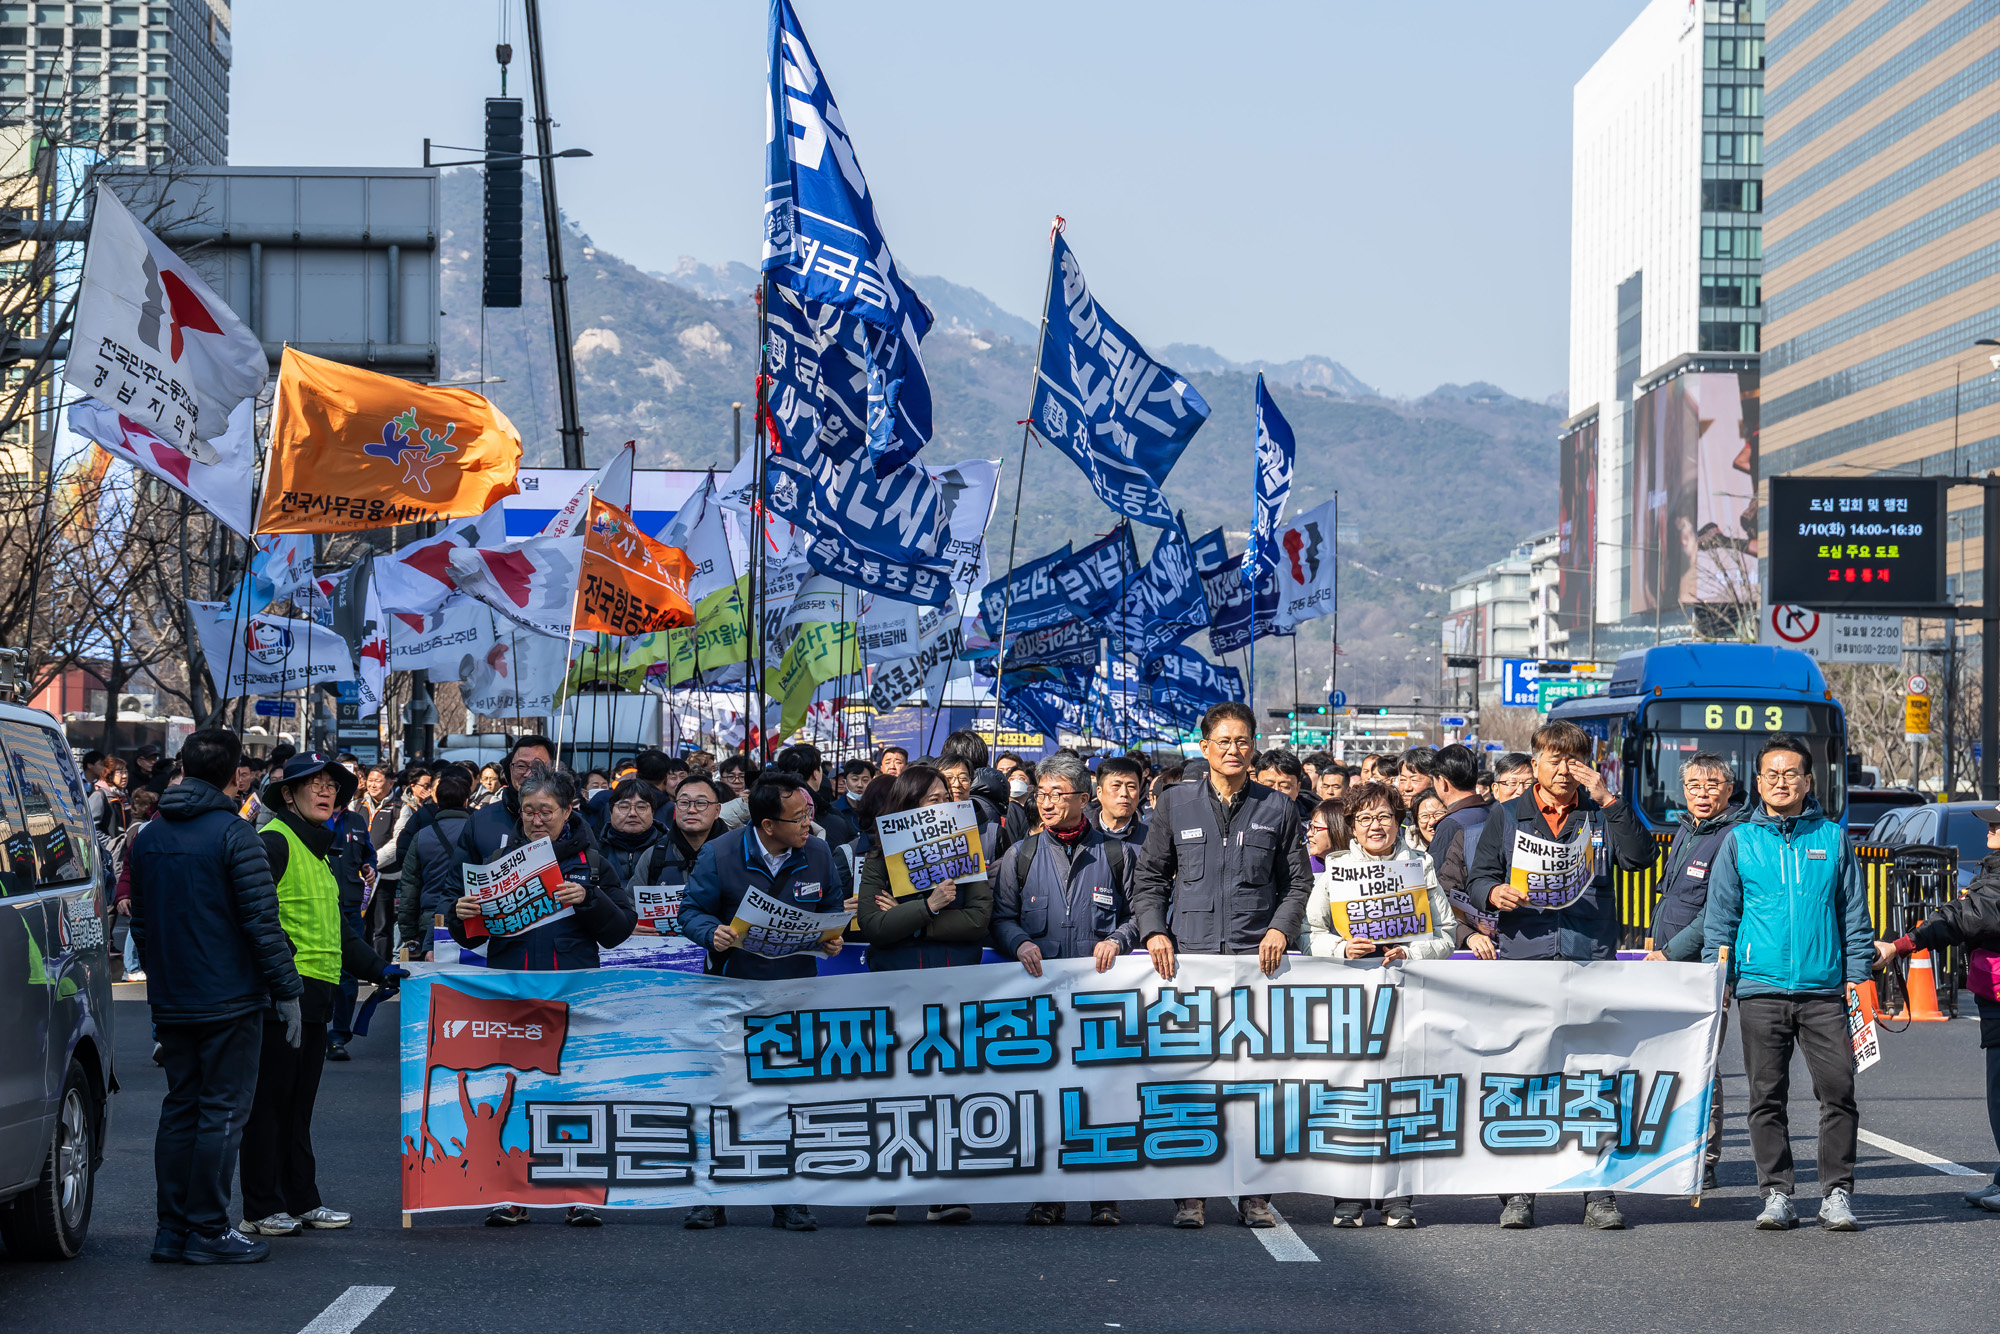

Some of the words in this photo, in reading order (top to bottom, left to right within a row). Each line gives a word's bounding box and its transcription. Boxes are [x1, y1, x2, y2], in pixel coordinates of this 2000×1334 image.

[1809, 498, 1834, 512] 도심
[1838, 498, 1863, 512] 집회
[1867, 498, 1880, 512] 및
[1883, 498, 1908, 512] 행진
[1798, 522, 1846, 537] 3/10(화)
[1850, 523, 1923, 536] 14:00~16:30
[1817, 545, 1842, 558] 도심
[1846, 545, 1871, 558] 주요
[1874, 545, 1900, 558] 도로
[1870, 626, 1899, 638] 22:00
[1912, 680, 1924, 690] 50
[1705, 704, 1783, 731] 603
[881, 808, 936, 835] 진짜사장
[912, 816, 959, 843] 나와라!
[902, 833, 969, 871] 원청교섭
[1517, 835, 1571, 858] 진짜사장
[466, 871, 488, 887] 모든
[490, 850, 527, 882] 노동자의
[908, 853, 980, 890] 쟁취하자!
[1331, 864, 1385, 883] 진짜사장
[469, 870, 520, 900] 노동기본권
[479, 875, 547, 919] 투쟁으로
[638, 891, 663, 905] 모든
[1359, 874, 1405, 898] 나와라!
[747, 889, 804, 921] 진짜사장
[1346, 894, 1415, 923] 원청교섭
[748, 924, 824, 945] 원청교섭
[768, 917, 821, 933] 나와라!
[1348, 912, 1426, 942] 쟁취하자!
[471, 1020, 543, 1040] 민주노총
[744, 1006, 900, 1083] 진짜
[908, 993, 1060, 1075] 사장
[525, 1100, 696, 1185] 모든
[708, 1088, 1044, 1180] 노동자의
[1057, 1073, 1467, 1172] 노동기본권
[1479, 1069, 1680, 1161] 쟁취!
